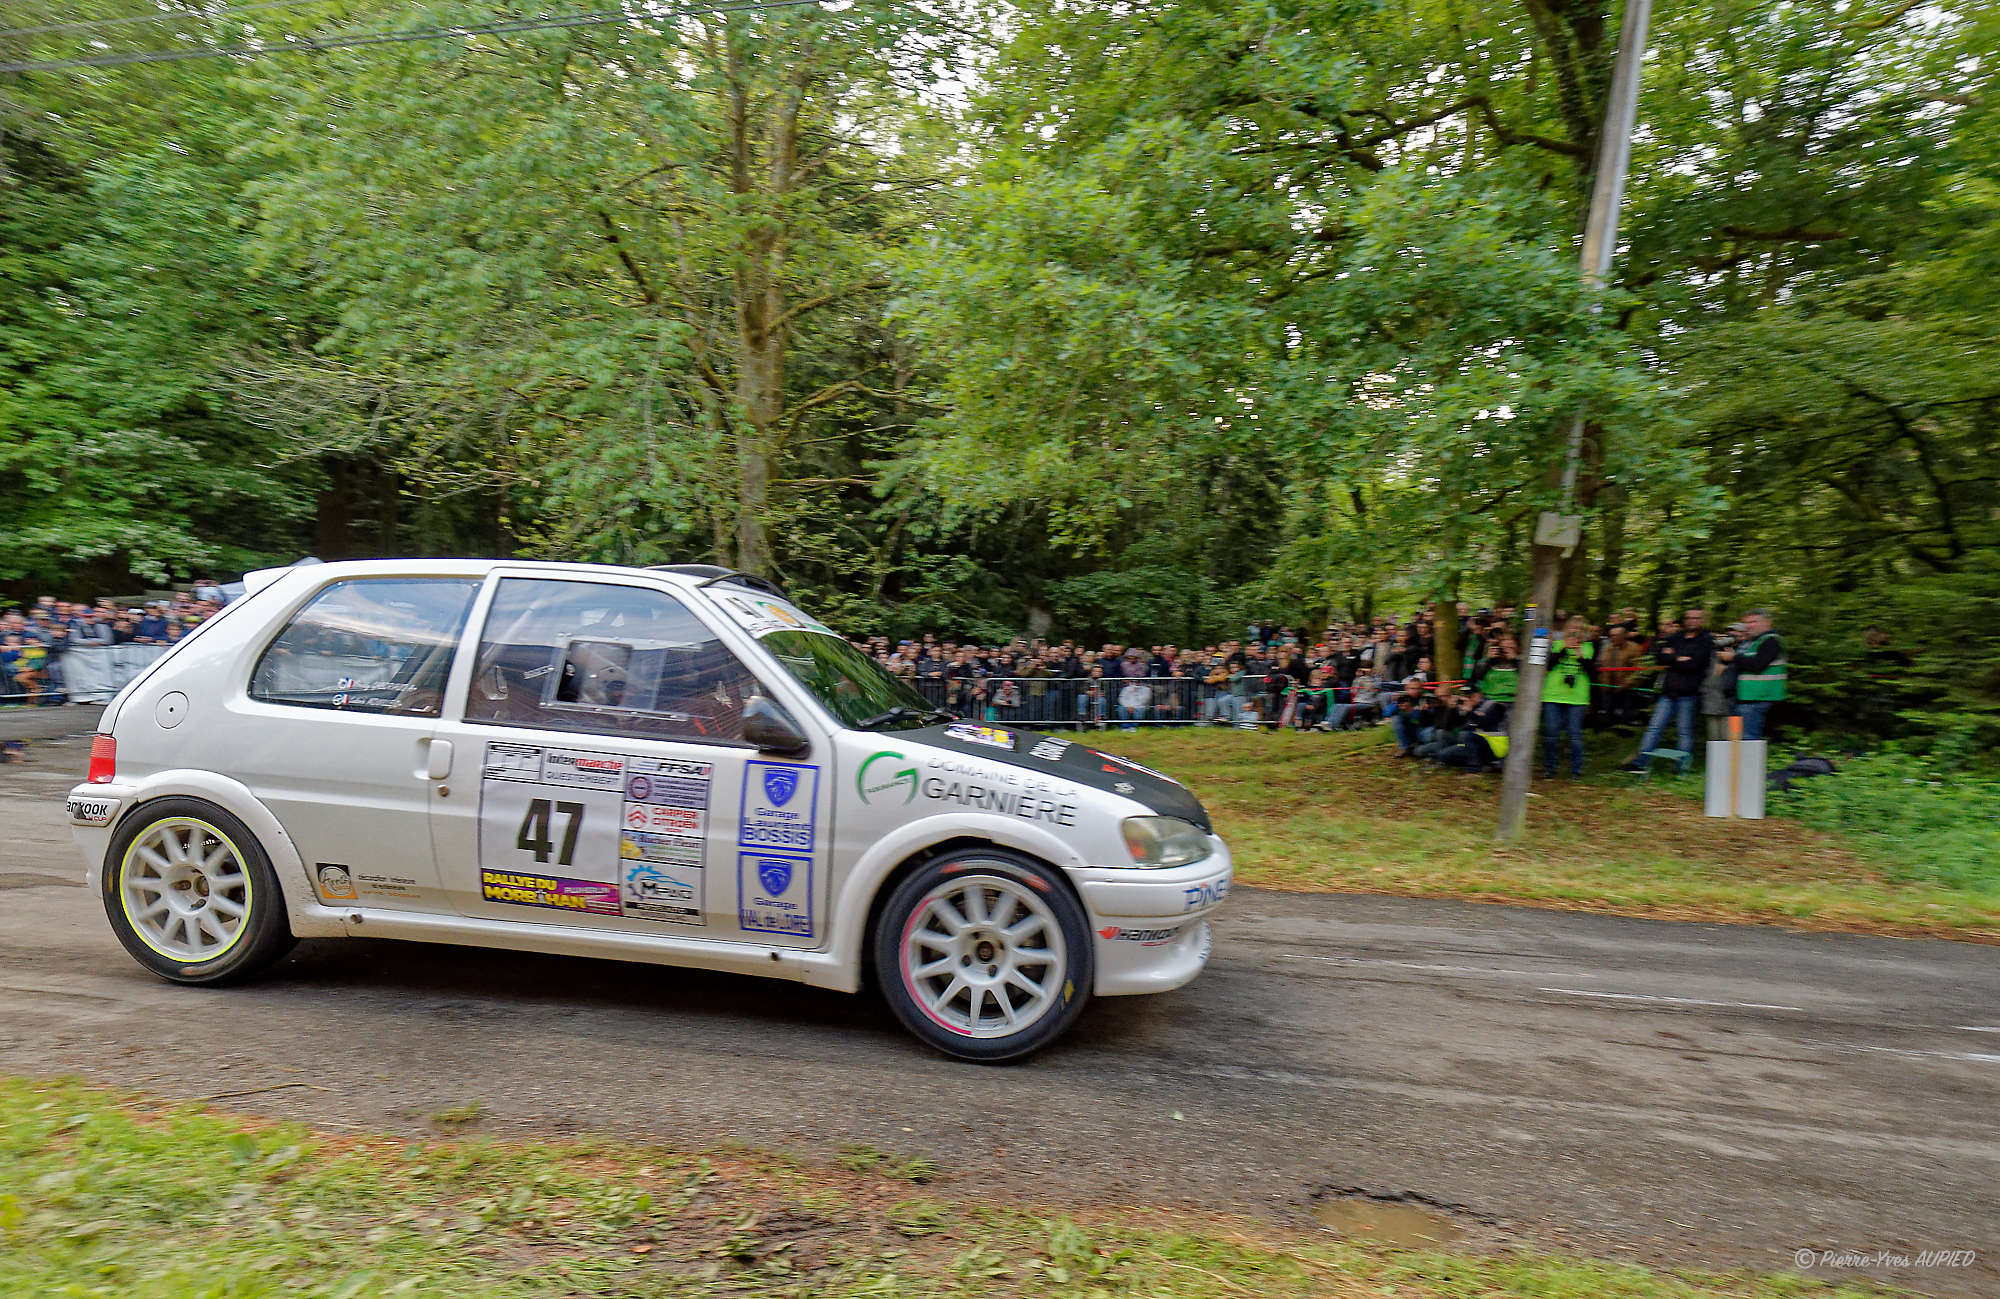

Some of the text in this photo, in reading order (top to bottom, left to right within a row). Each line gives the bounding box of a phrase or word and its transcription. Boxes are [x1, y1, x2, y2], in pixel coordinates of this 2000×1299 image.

[657, 762, 704, 776] FFSA
[1023, 778, 1050, 793] DE
[921, 777, 1078, 827] GARNIÈRE
[754, 807, 799, 820] Garage
[517, 798, 584, 866] 47
[744, 827, 810, 845] BOSSIS
[483, 872, 536, 888] RALLYE
[536, 877, 557, 891] DU
[753, 897, 798, 910] Garage
